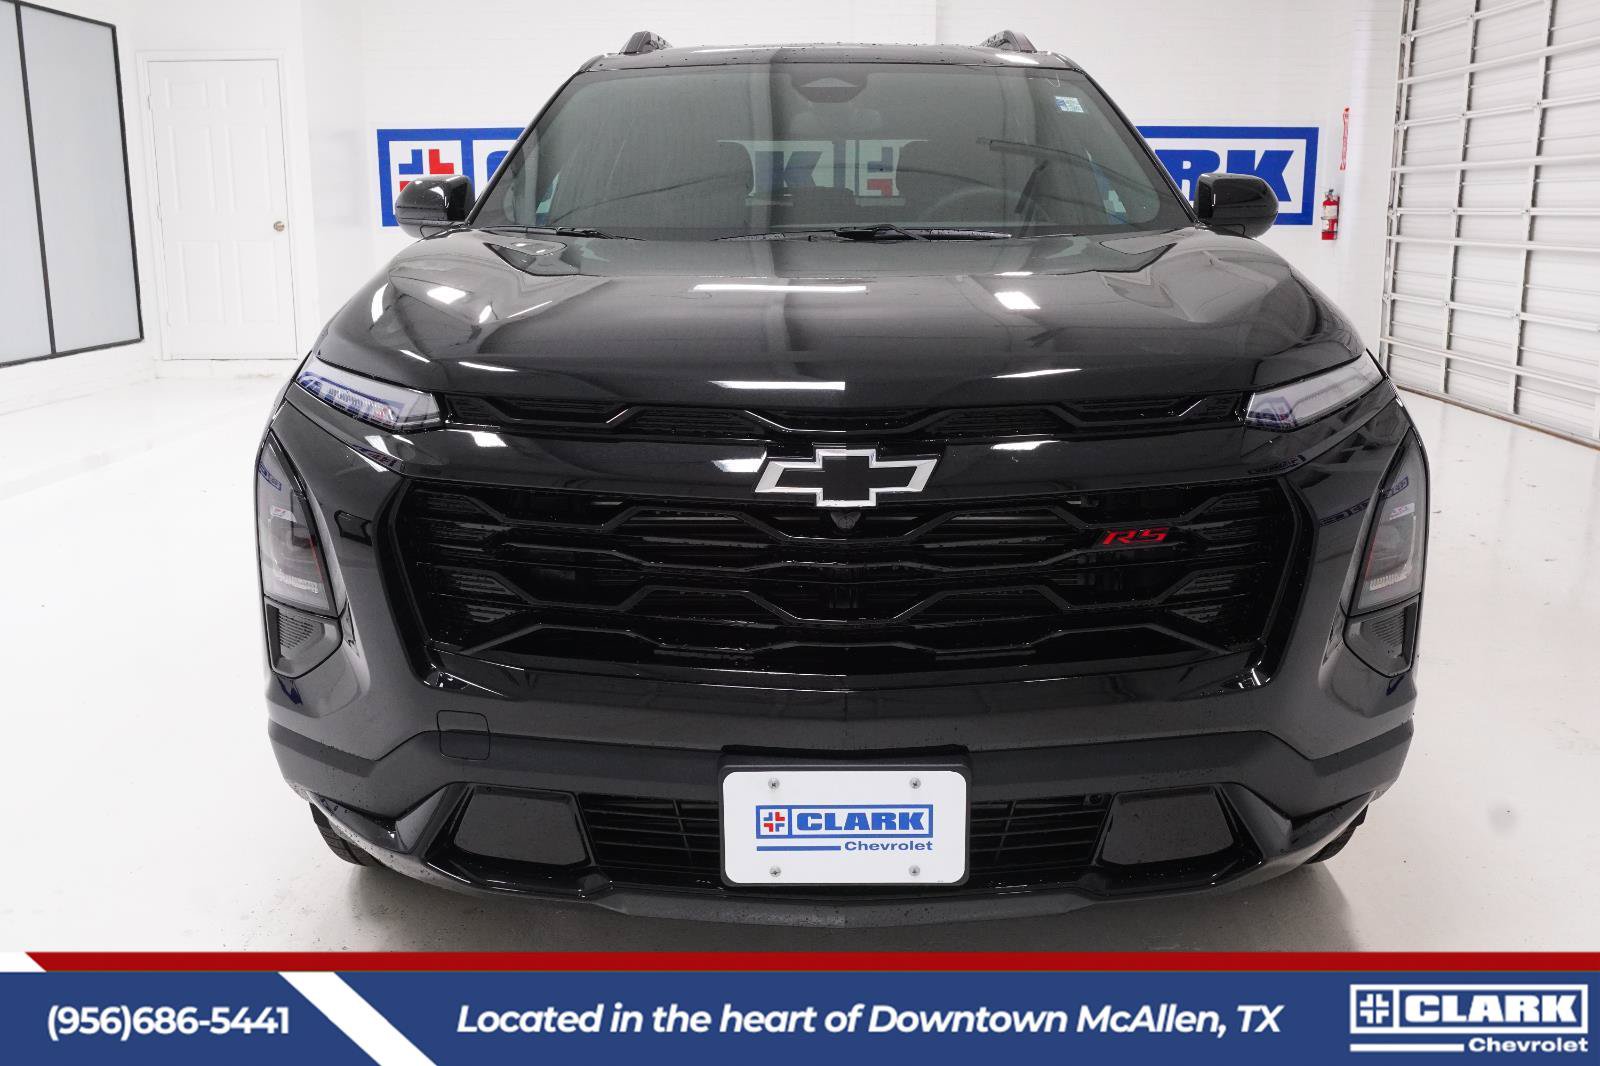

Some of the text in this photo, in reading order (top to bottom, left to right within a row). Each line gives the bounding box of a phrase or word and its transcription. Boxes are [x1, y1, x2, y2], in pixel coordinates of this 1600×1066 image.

[1102, 527, 1168, 545] RS
[796, 811, 925, 832] CLARK
[844, 840, 933, 851] Chevrolet
